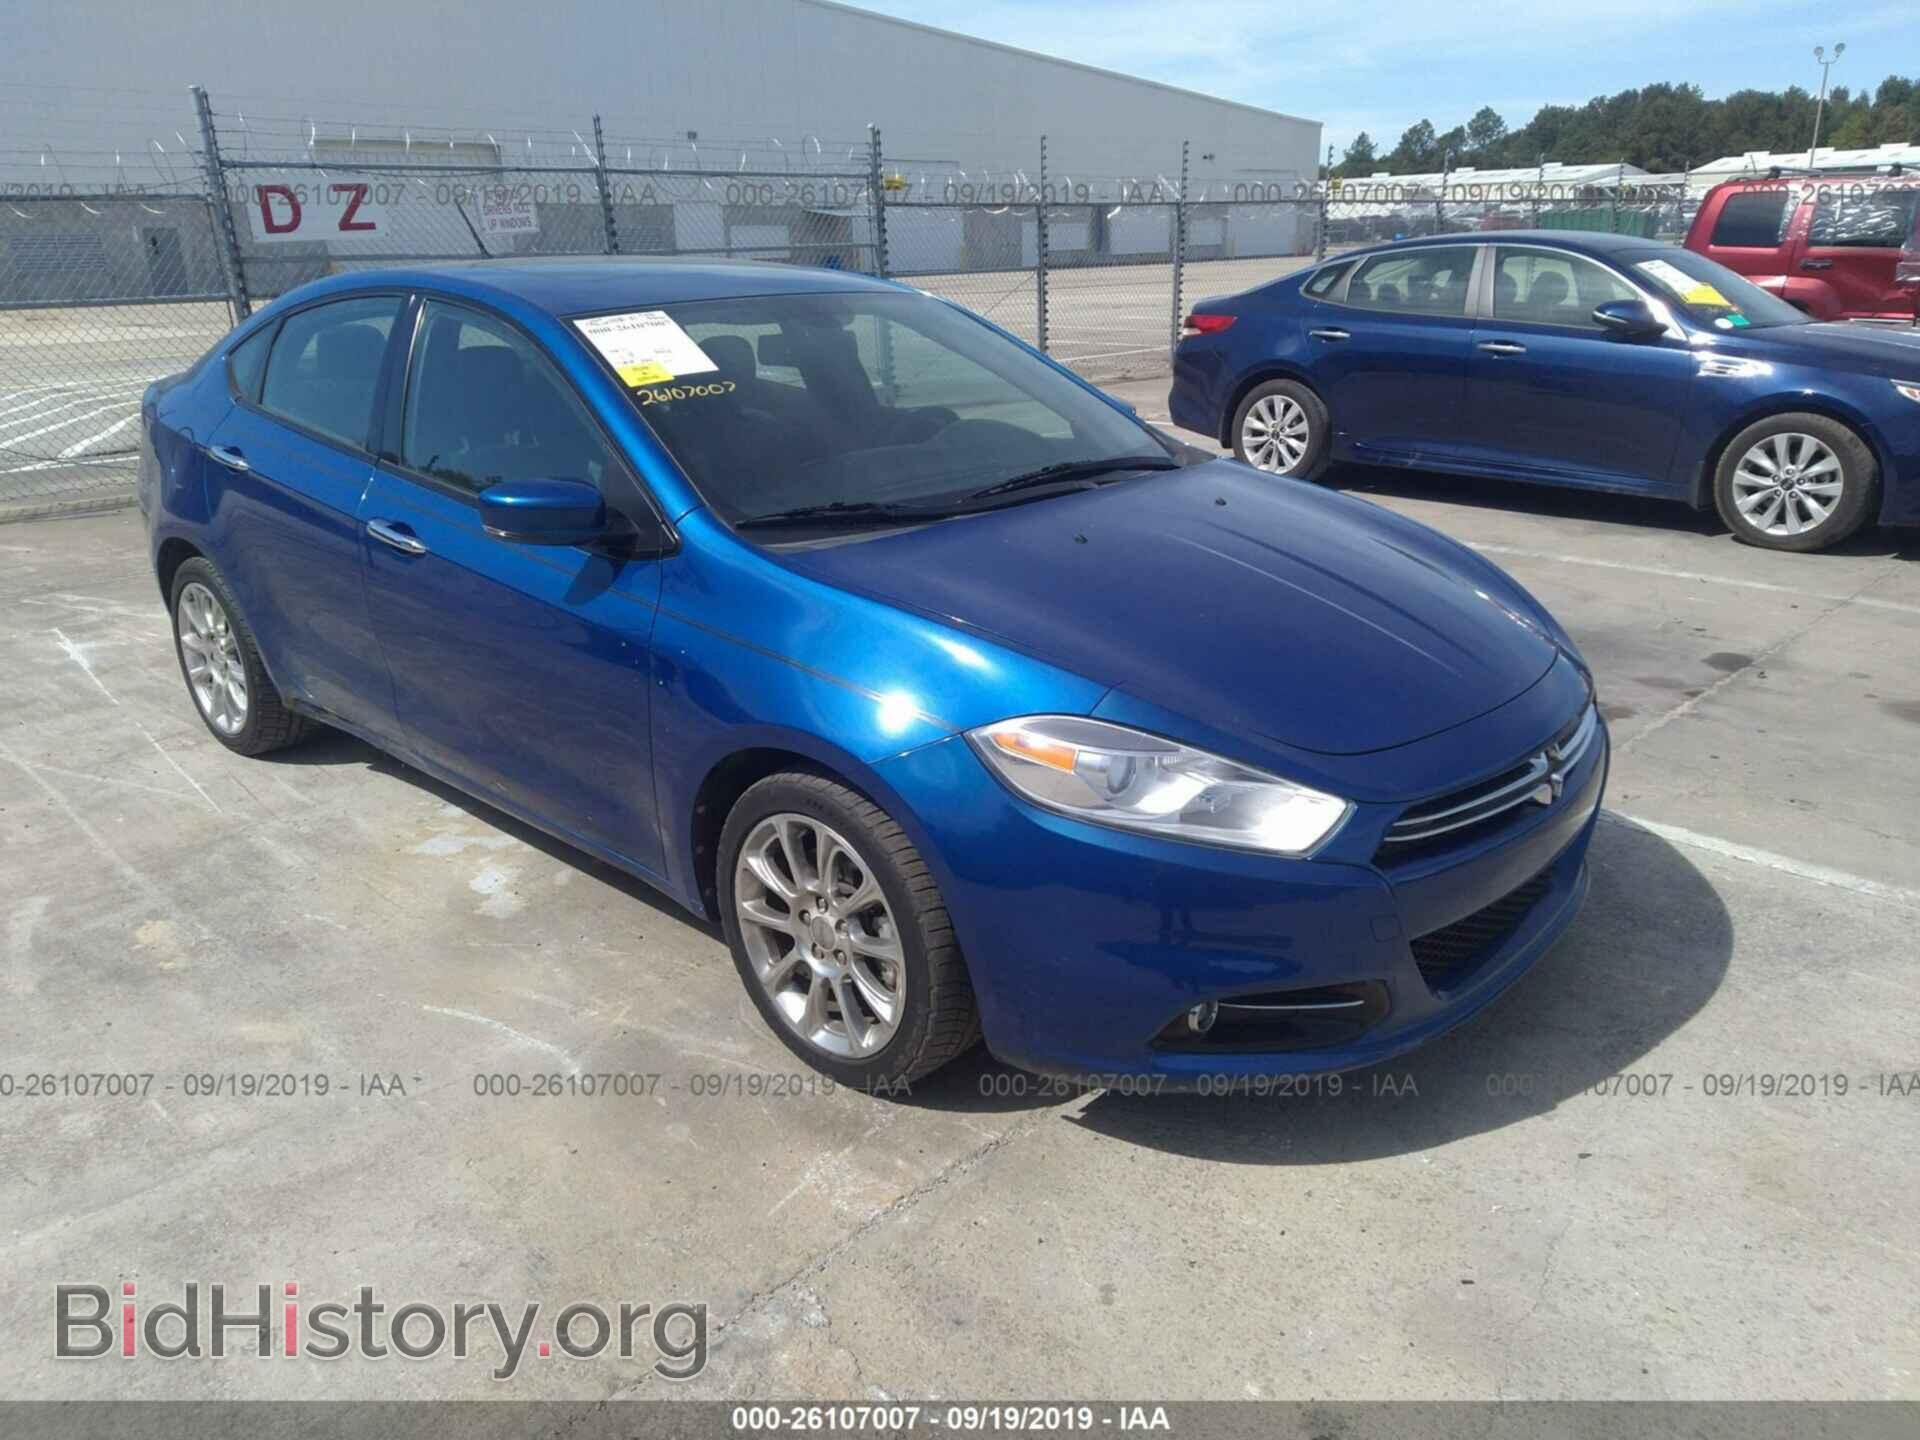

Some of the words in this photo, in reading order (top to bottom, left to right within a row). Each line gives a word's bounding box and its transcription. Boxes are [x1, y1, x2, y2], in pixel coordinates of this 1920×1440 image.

[257, 184, 302, 234] D
[330, 183, 377, 231] Z
[636, 381, 736, 406] 26107007
